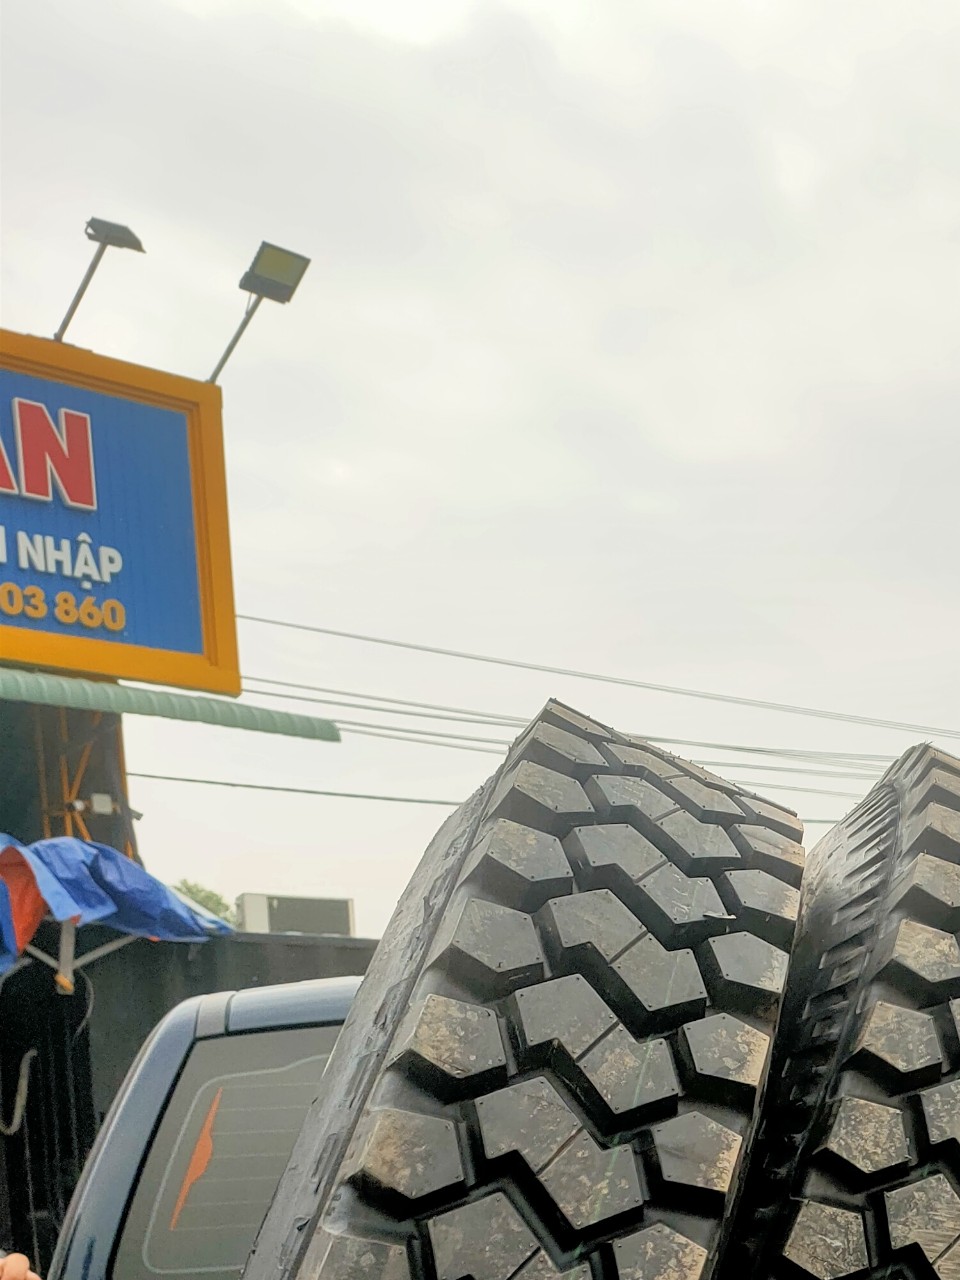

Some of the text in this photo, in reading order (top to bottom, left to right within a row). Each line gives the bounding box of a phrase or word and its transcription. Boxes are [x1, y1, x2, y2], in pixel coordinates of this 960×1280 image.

[17, 530, 123, 590] NHẬP
[0, 581, 126, 631] 03 860
